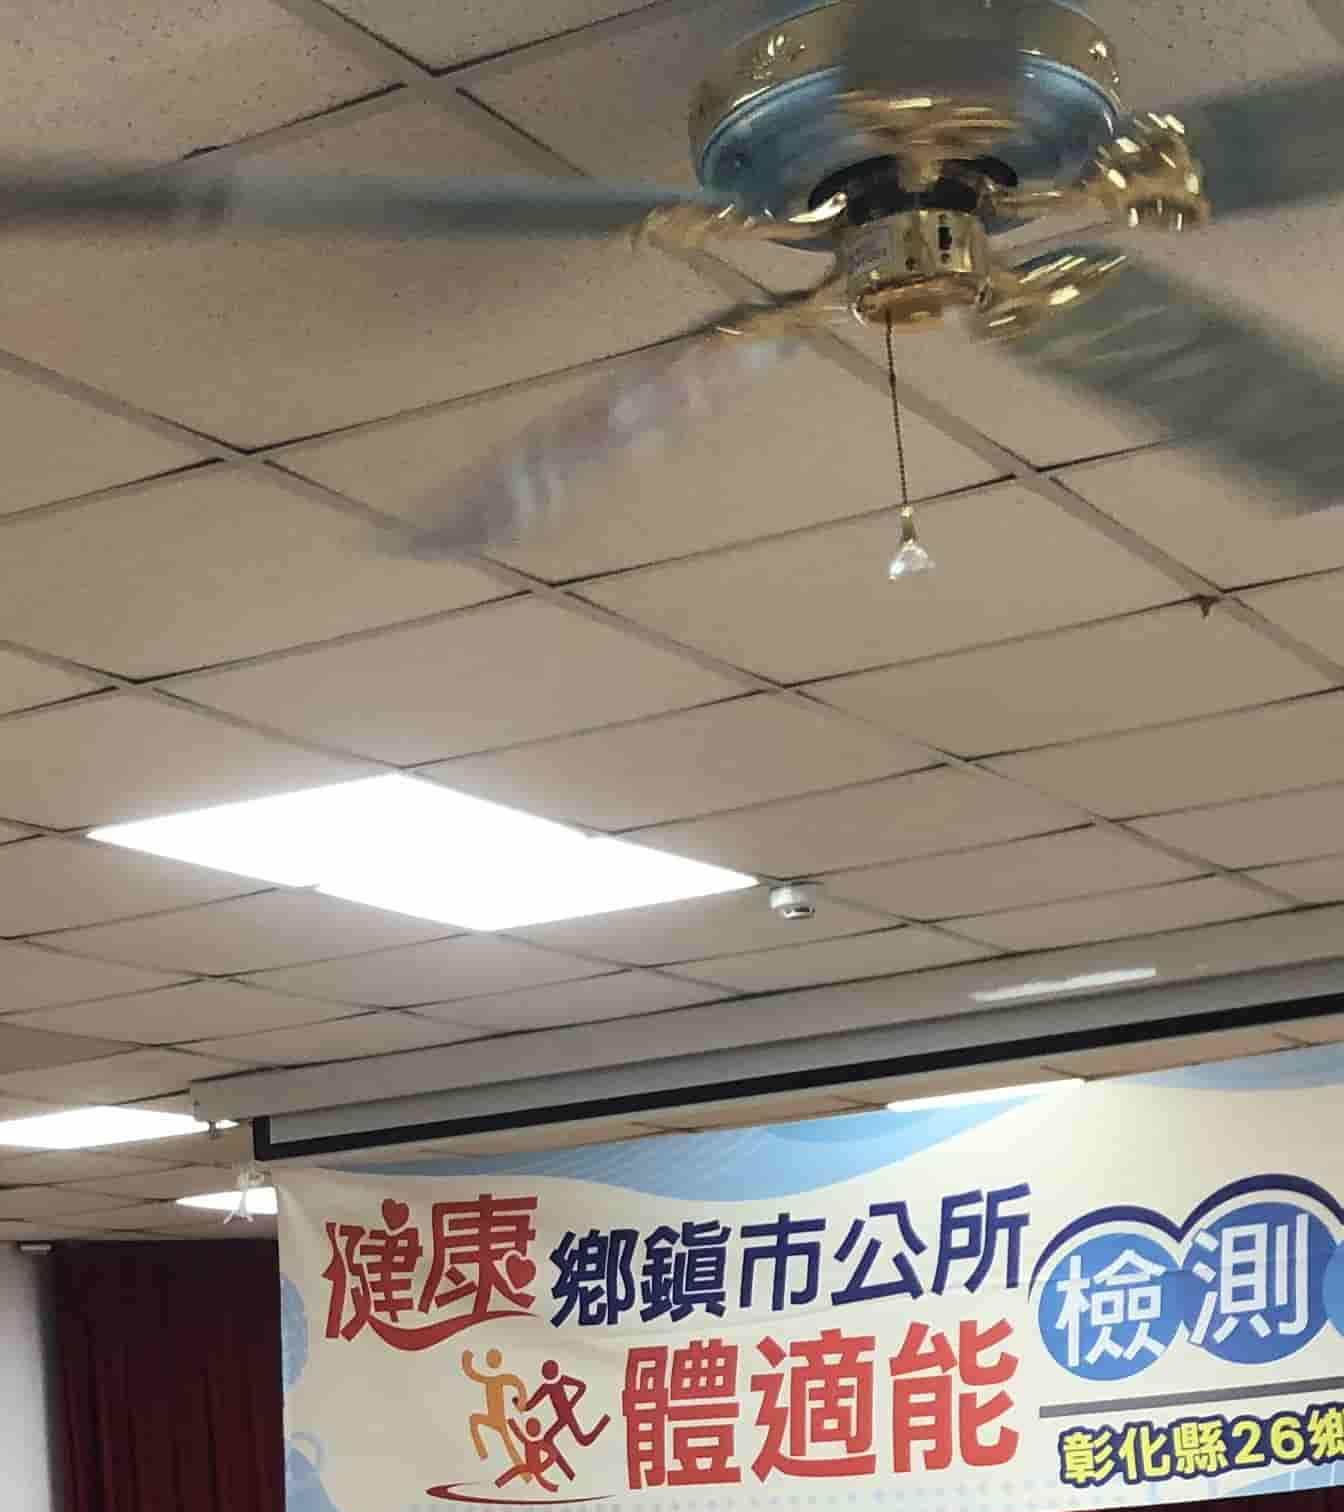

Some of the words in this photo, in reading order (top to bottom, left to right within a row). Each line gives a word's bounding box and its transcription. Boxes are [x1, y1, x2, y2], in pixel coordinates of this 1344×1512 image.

[323, 1192, 542, 1352] 健康
[549, 1183, 1033, 1328] 鄉鎮市公所
[622, 1319, 1019, 1491] 體適能
